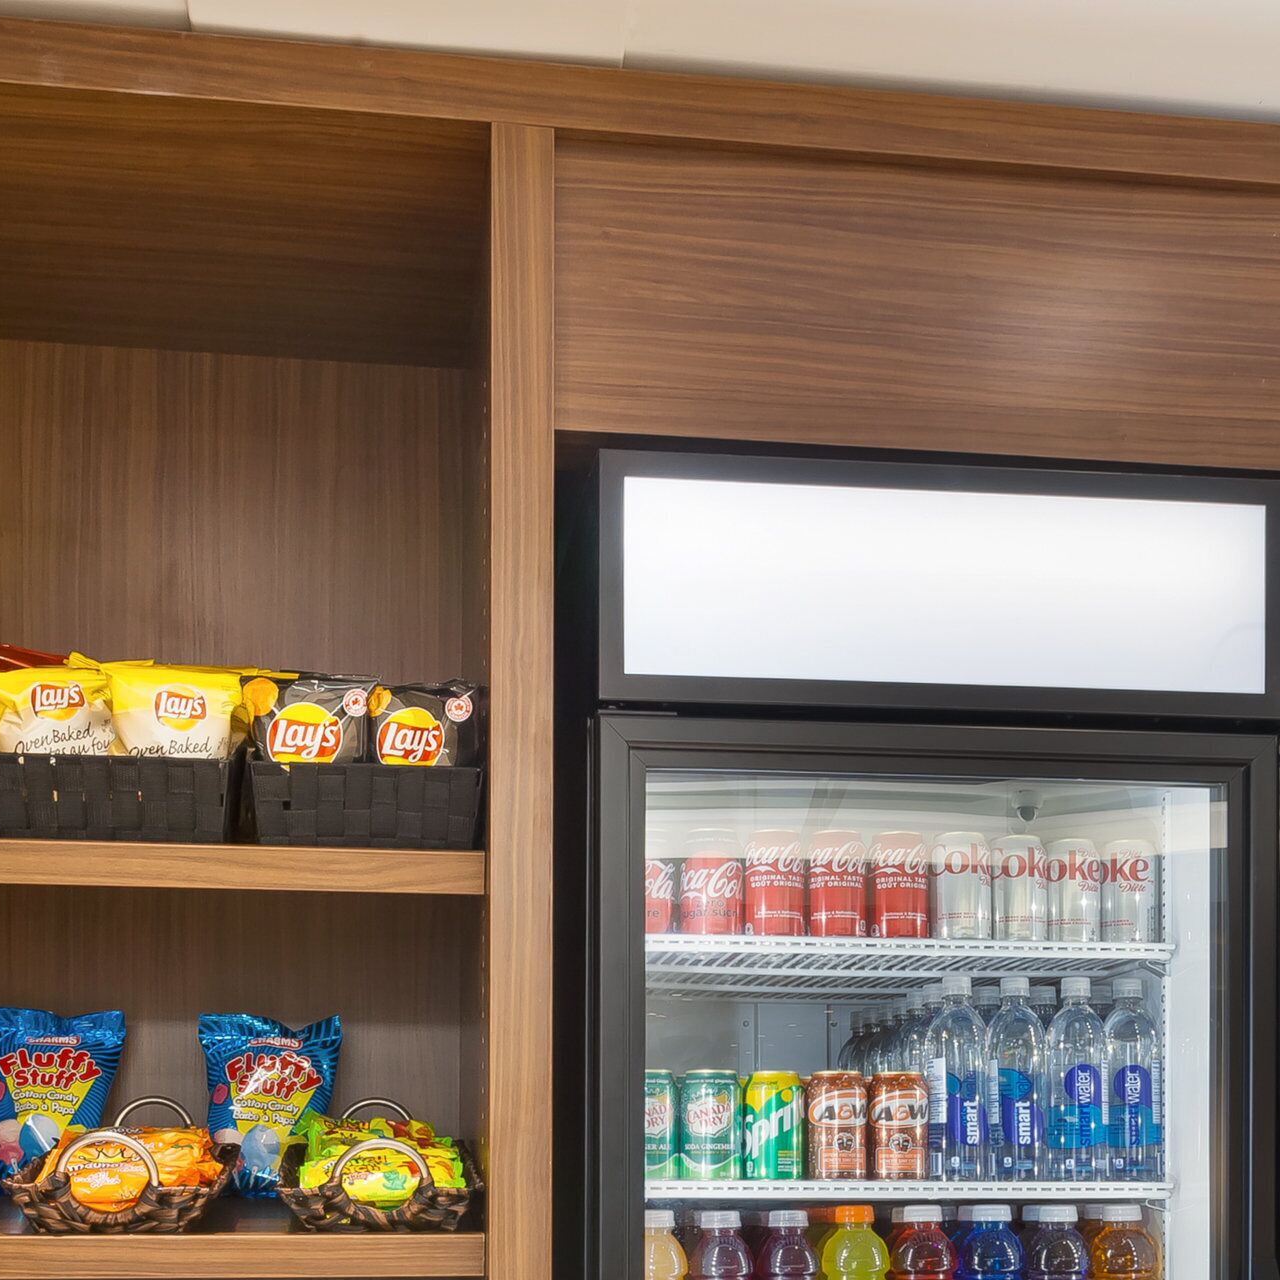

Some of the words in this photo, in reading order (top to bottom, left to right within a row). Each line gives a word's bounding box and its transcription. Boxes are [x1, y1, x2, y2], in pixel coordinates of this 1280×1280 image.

[34, 683, 82, 713] Lay's
[158, 690, 207, 720] Lay's
[14, 735, 53, 755] Oven
[52, 721, 96, 744] Baked
[168, 735, 213, 755] Baked
[271, 717, 342, 762] Lay's
[380, 721, 443, 764] Lay's
[13, 1067, 77, 1091] Stuff
[1076, 1069, 1091, 1104] water
[1124, 1069, 1141, 1104] water
[11, 1089, 46, 1101] Cotton
[47, 1090, 80, 1106] Candy
[51, 1102, 76, 1116] Papa
[233, 1097, 267, 1111] Cotton
[268, 1100, 300, 1116] Candy
[272, 1112, 296, 1126] Papa
[688, 1103, 733, 1125] CANADA
[700, 1116, 726, 1129] DRY
[963, 1100, 980, 1145] smart
[1015, 1100, 1031, 1146] smart
